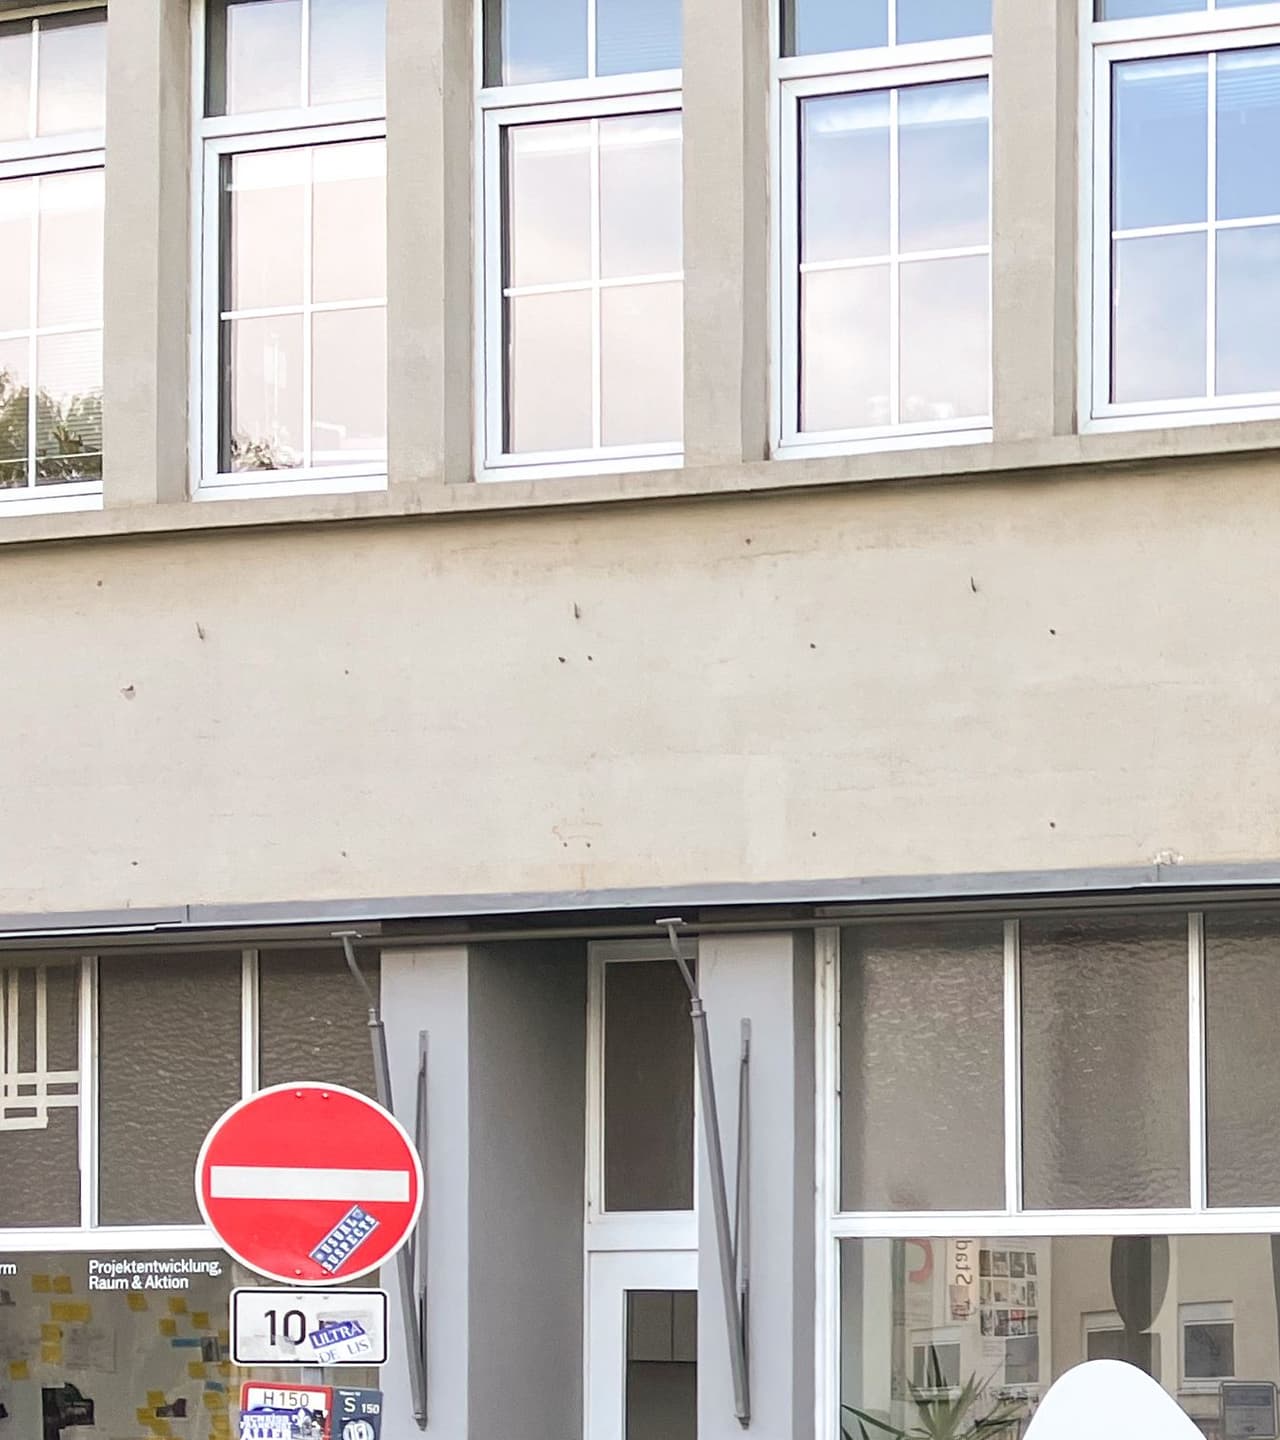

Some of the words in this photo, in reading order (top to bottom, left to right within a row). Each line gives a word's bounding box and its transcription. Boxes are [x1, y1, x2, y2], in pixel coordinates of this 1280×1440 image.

[320, 1218, 358, 1254] USUAL
[321, 1214, 376, 1272] SUSPECTS
[88, 1258, 223, 1277] Projektentwicklung,
[88, 1274, 129, 1290] Raum
[130, 1274, 143, 1290] &
[144, 1273, 189, 1289] Aktion
[264, 1309, 306, 1346] 10
[279, 1392, 310, 1408] 150
[343, 1397, 356, 1413] S
[361, 1403, 380, 1415] 150
